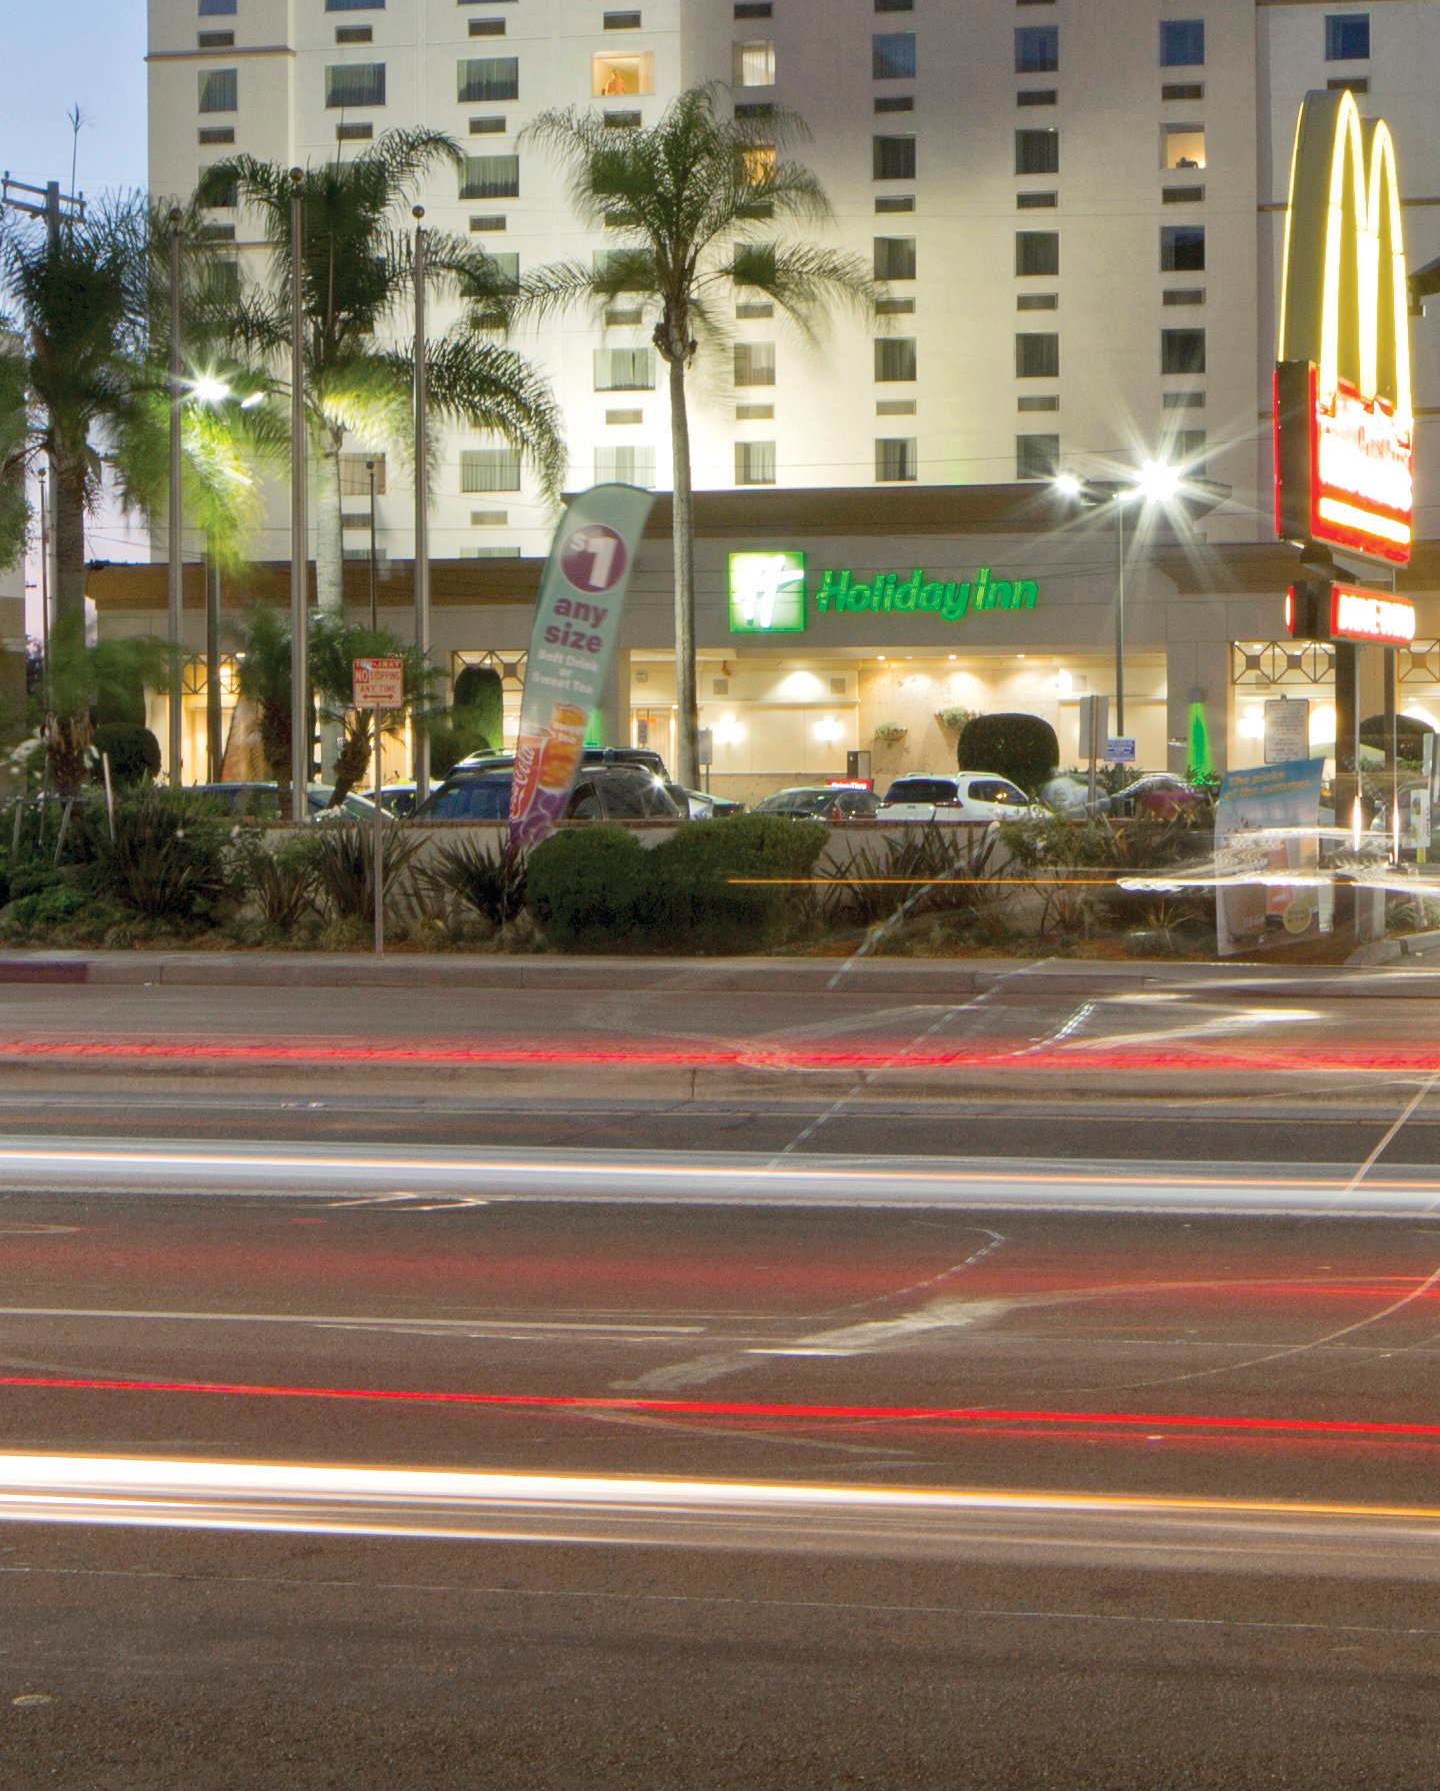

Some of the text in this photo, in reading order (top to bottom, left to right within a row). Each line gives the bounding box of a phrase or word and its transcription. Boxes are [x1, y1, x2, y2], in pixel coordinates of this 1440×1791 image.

[816, 566, 1039, 621] Holiday Inn
[553, 597, 609, 629] any
[544, 621, 603, 654] size
[355, 670, 369, 683] NO
[380, 684, 397, 692] TIME
